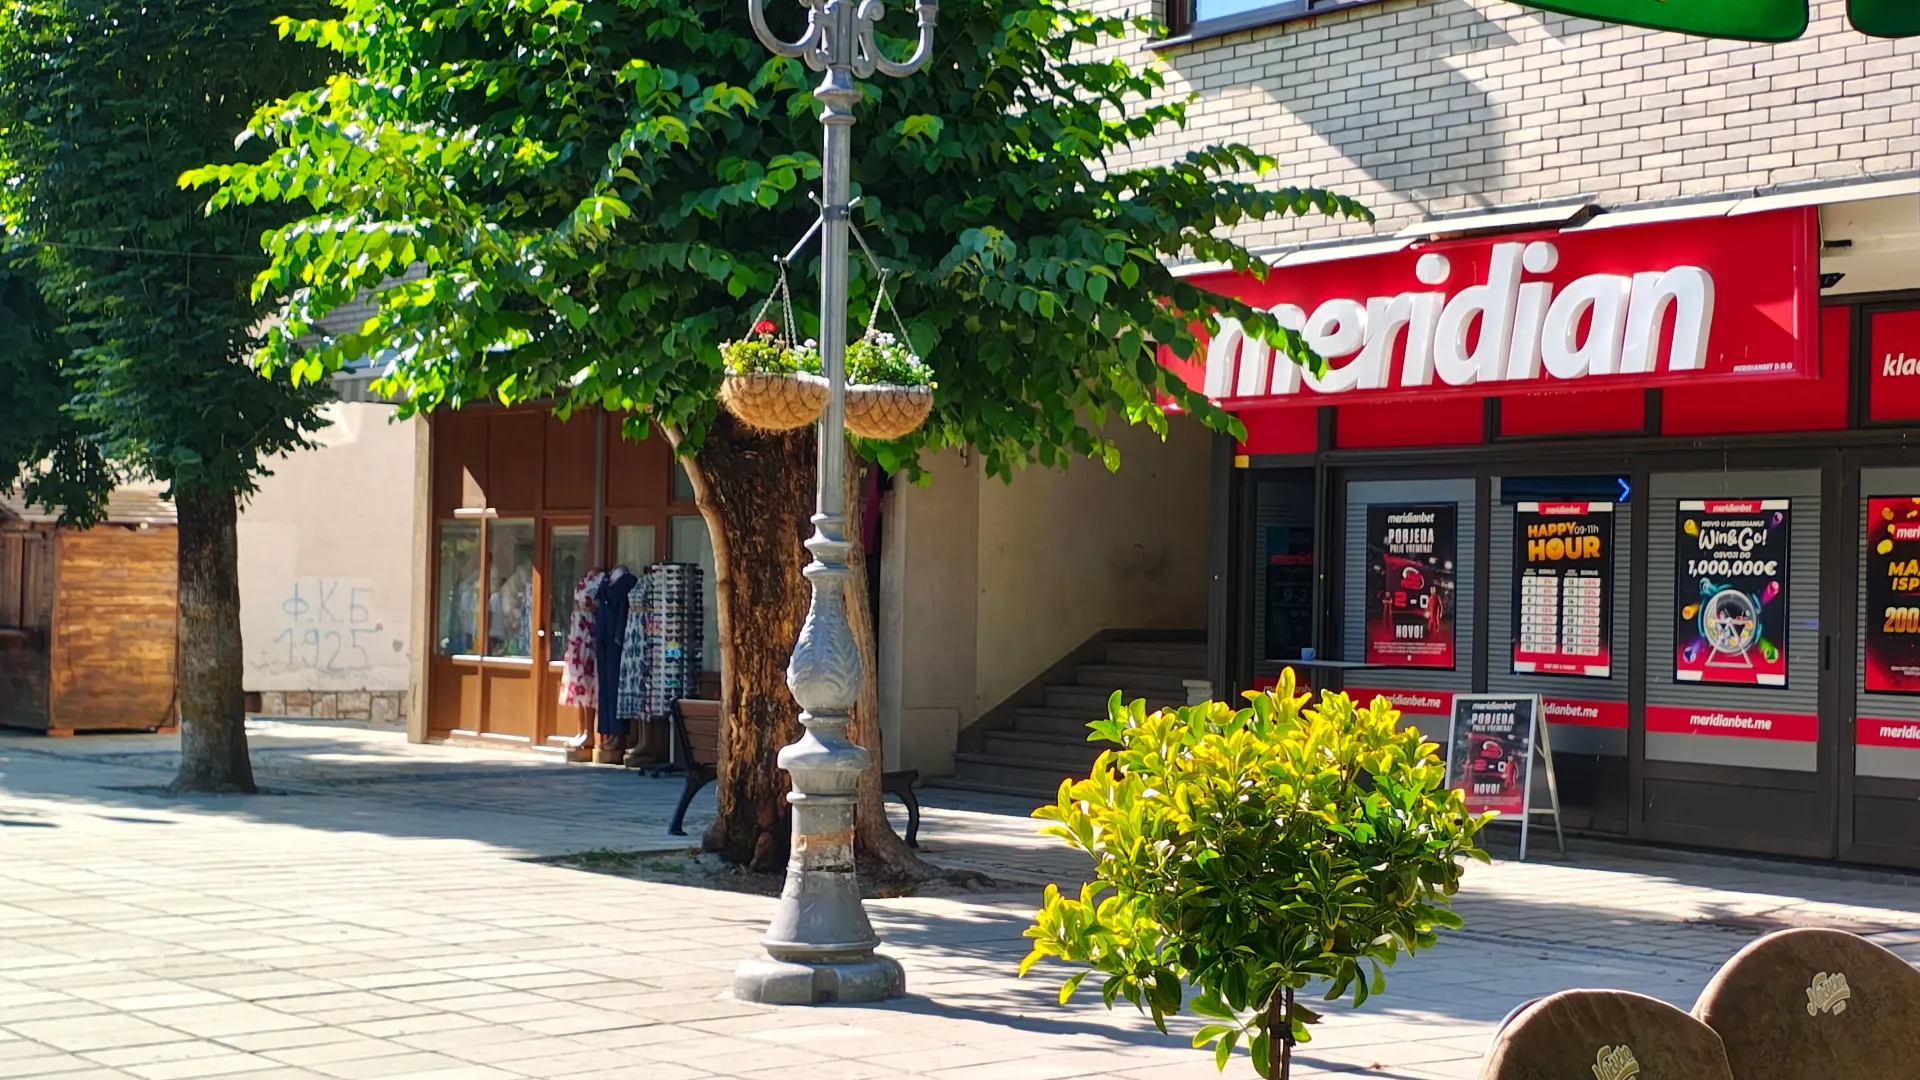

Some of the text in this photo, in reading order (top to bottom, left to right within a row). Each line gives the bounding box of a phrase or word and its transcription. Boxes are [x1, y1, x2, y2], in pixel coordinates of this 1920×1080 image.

[1204, 241, 1713, 398] meridian
[1387, 512, 1435, 524] meridianbet
[1388, 528, 1434, 544] POBJEDA
[1527, 522, 1577, 537] HAPPY
[1698, 527, 1767, 551] Win&Go!
[1528, 536, 1601, 562] HOUR
[1713, 551, 1751, 559] OSVOJI DO
[1688, 560, 1778, 578] 1,000,000€
[1395, 625, 1424, 638] NOVO!
[274, 627, 376, 673] 1925
[1471, 712, 1515, 725] POBJEDA
[1690, 713, 1772, 731] meridianbet.me
[1473, 783, 1501, 795] NOVO!
